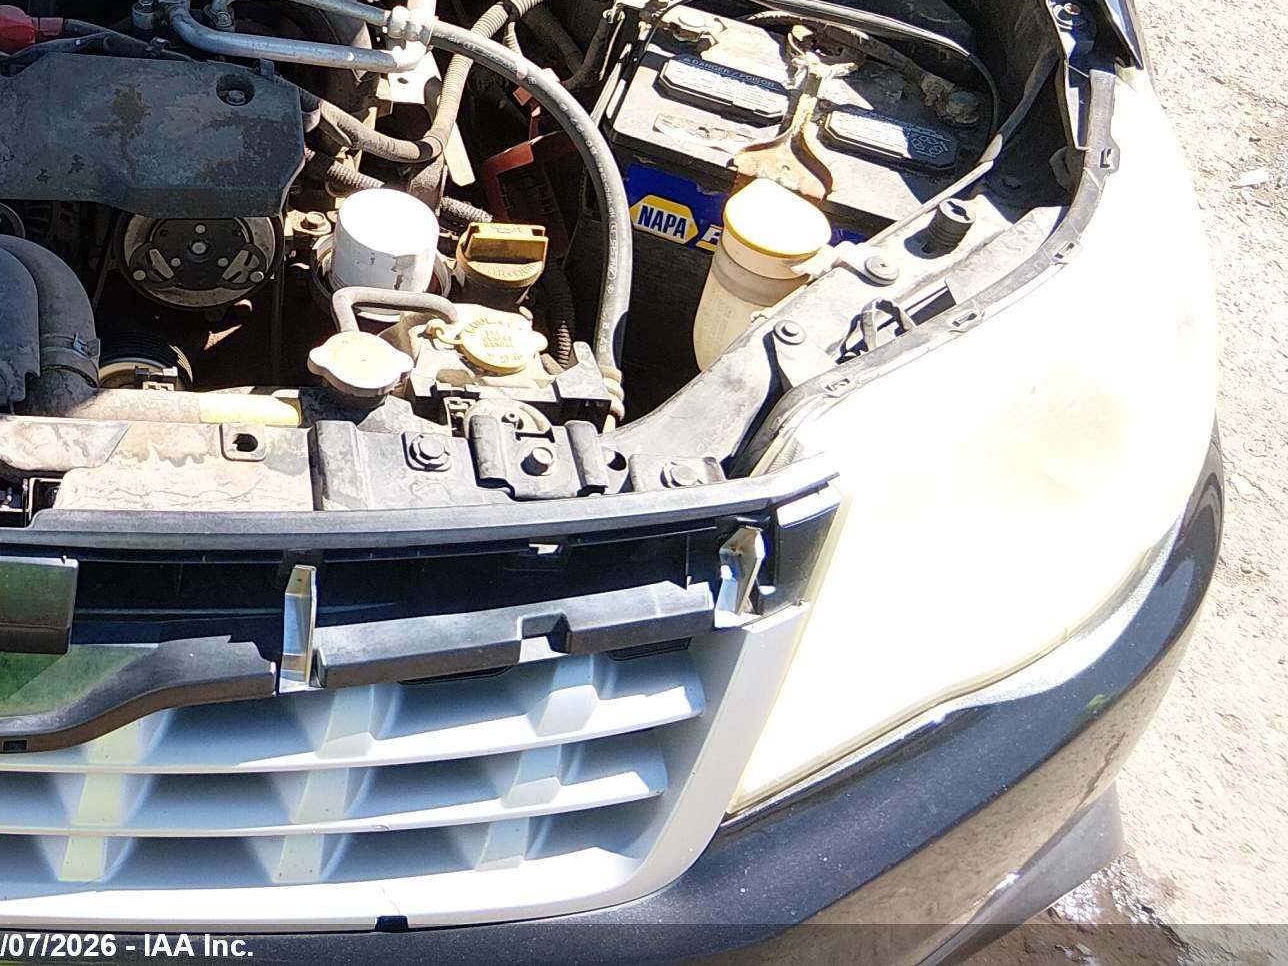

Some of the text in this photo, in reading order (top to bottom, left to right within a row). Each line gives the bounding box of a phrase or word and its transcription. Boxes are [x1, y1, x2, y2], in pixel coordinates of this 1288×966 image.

[692, 59, 731, 76] DANGER
[740, 73, 775, 88] POISON
[638, 205, 687, 239] NAPA
